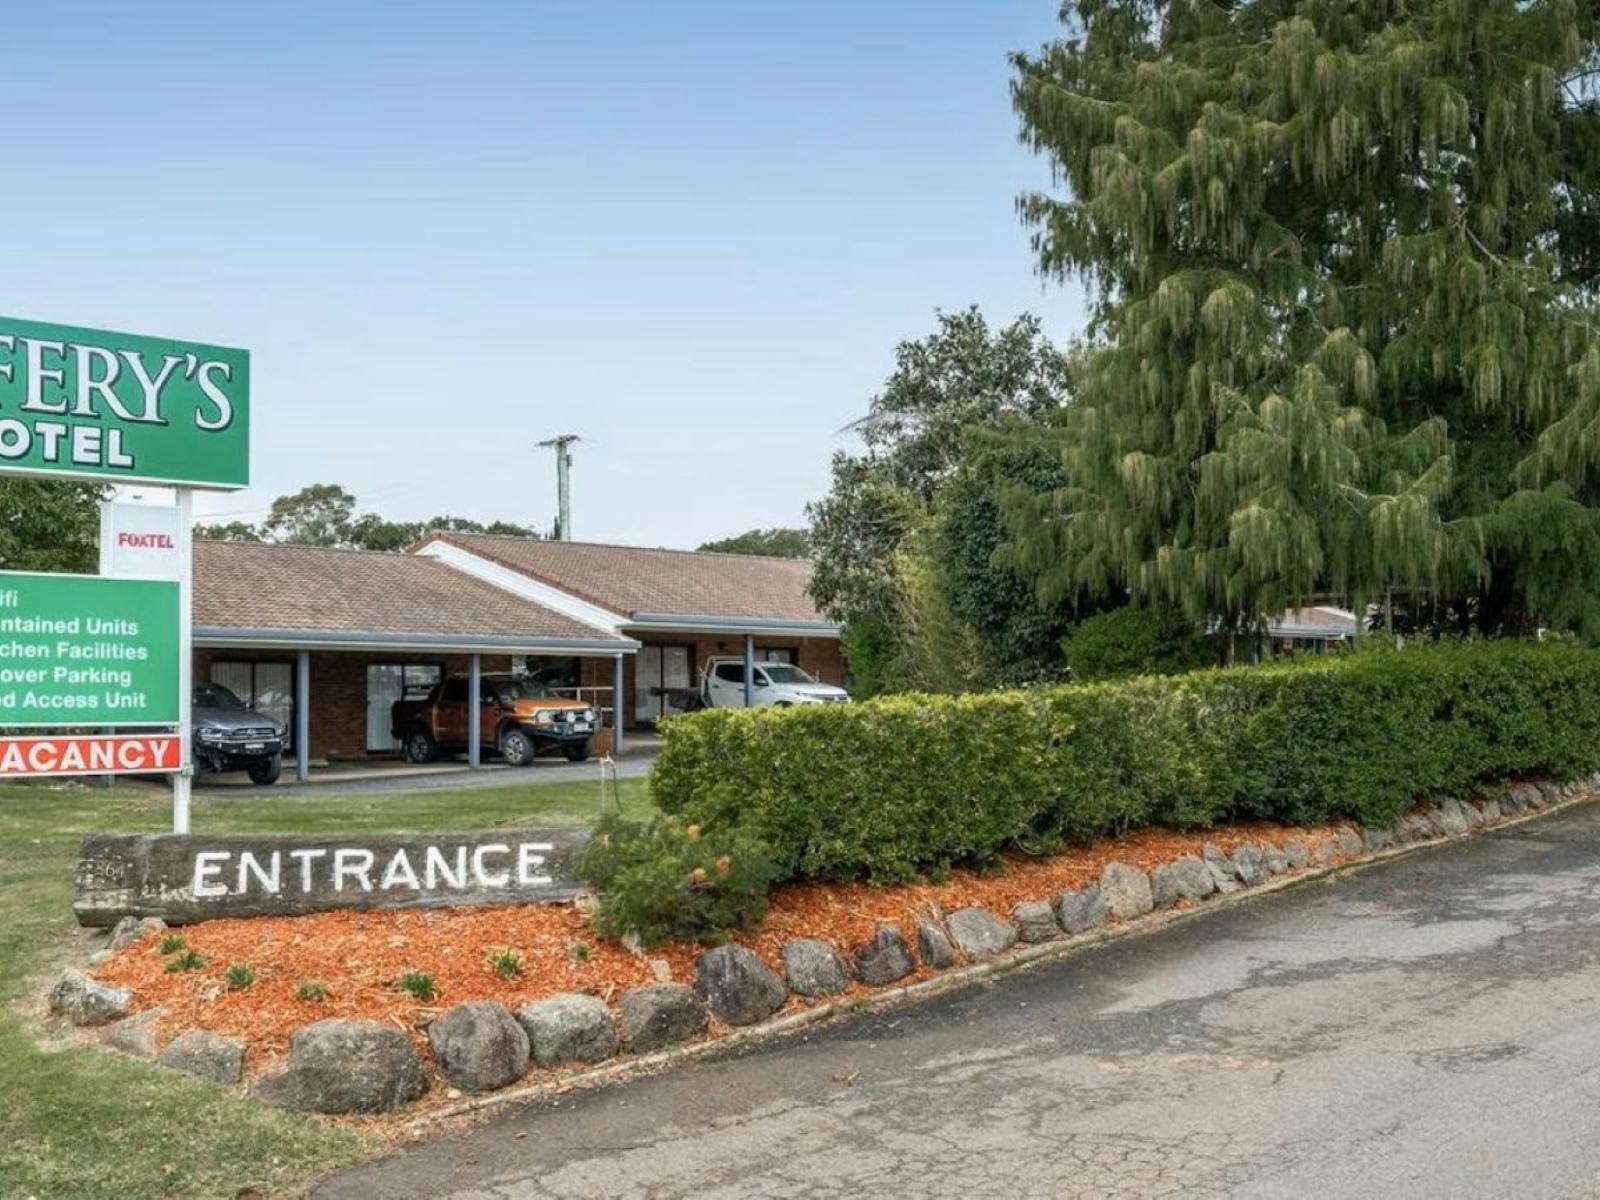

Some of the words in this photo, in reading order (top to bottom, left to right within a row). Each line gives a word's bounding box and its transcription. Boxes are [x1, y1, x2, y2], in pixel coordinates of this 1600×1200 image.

[0, 418, 134, 467] OTEL
[118, 532, 174, 549] FOXTEL
[0, 616, 80, 634] ntained
[86, 617, 139, 636] Units
[0, 641, 49, 658] chen
[57, 642, 148, 661] Facilities
[0, 668, 48, 683] over
[53, 666, 132, 687] Parking
[22, 691, 99, 708] Access
[105, 692, 147, 708] Unit
[0, 740, 170, 771] ACANCY
[192, 842, 554, 897] ENTRANCE
